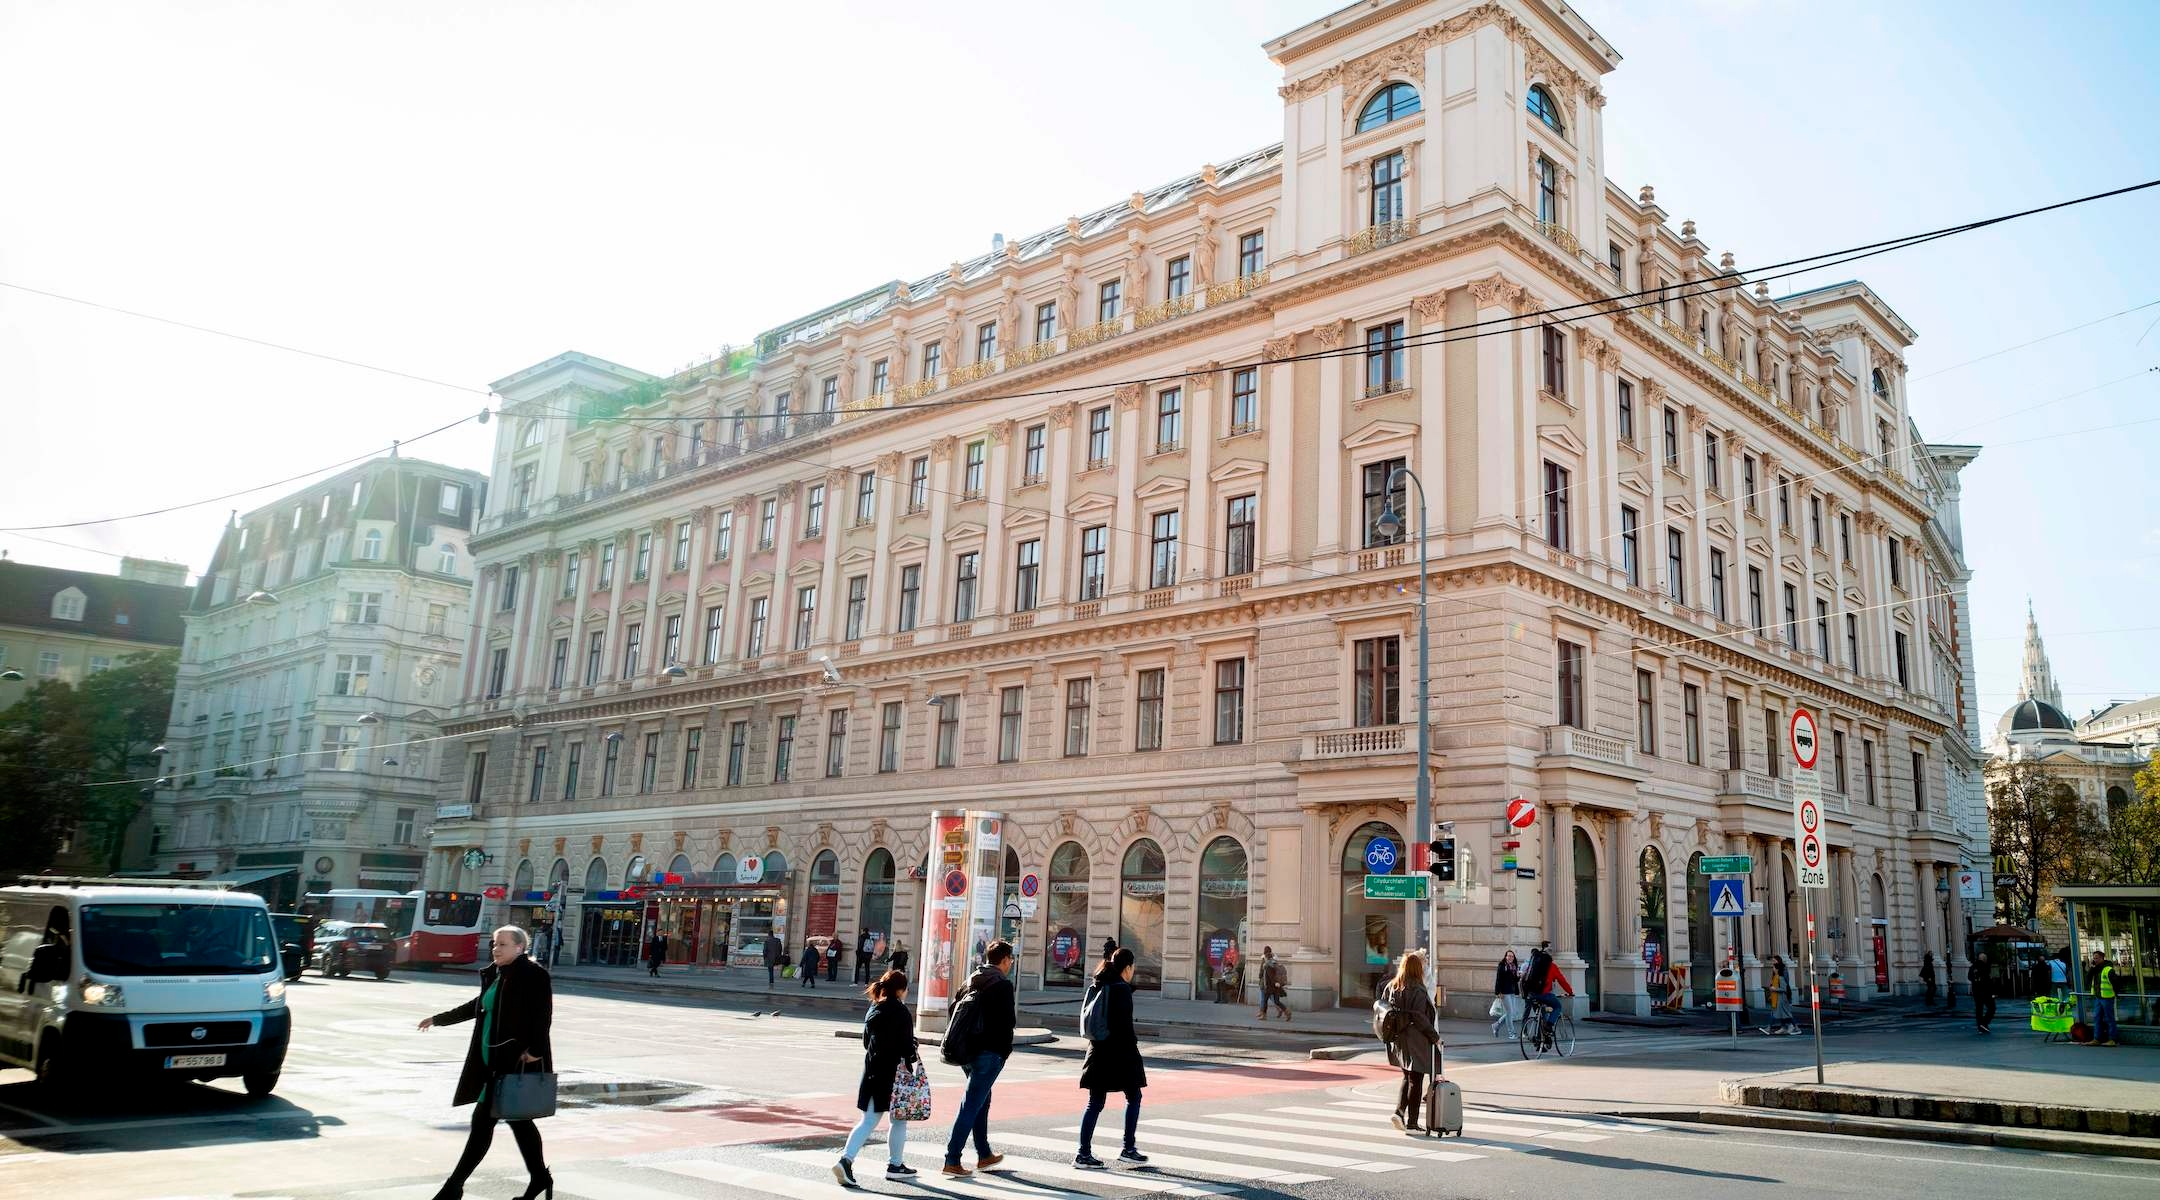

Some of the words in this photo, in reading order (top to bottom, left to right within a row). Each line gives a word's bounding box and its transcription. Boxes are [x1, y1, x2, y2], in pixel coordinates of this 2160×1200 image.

[1805, 809, 1814, 825] 30
[1373, 877, 1408, 885] Citydurchfahrt
[1801, 868, 1824, 885] Zone
[1133, 881, 1146, 891] Bank
